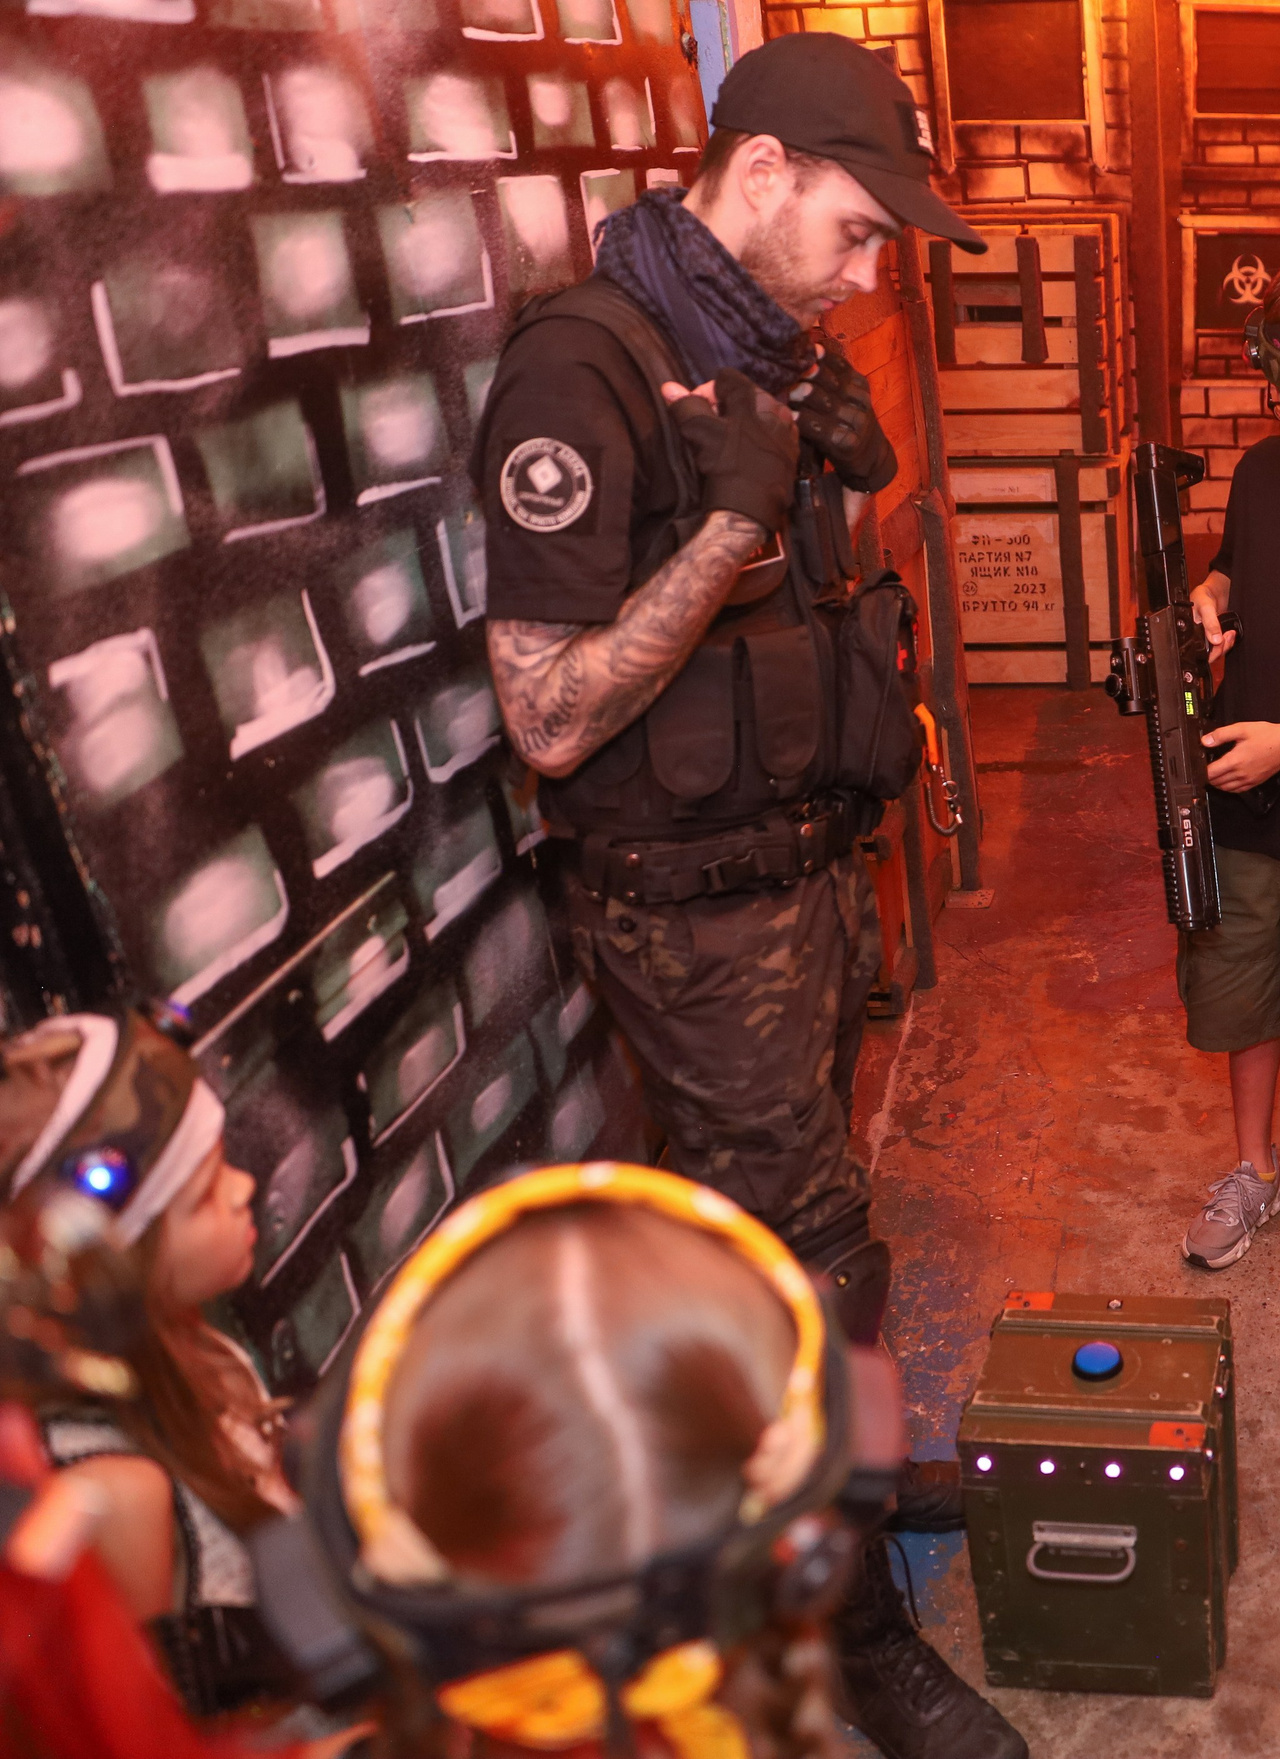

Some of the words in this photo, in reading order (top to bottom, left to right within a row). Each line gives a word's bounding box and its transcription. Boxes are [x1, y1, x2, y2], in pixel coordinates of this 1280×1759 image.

[959, 552, 1011, 563] ПАРТИЯ
[971, 566, 1011, 578] ЯЩИК
[1013, 583, 1047, 595] 2023
[962, 601, 1018, 612] БРУТТО
[1023, 601, 1039, 612] 94
